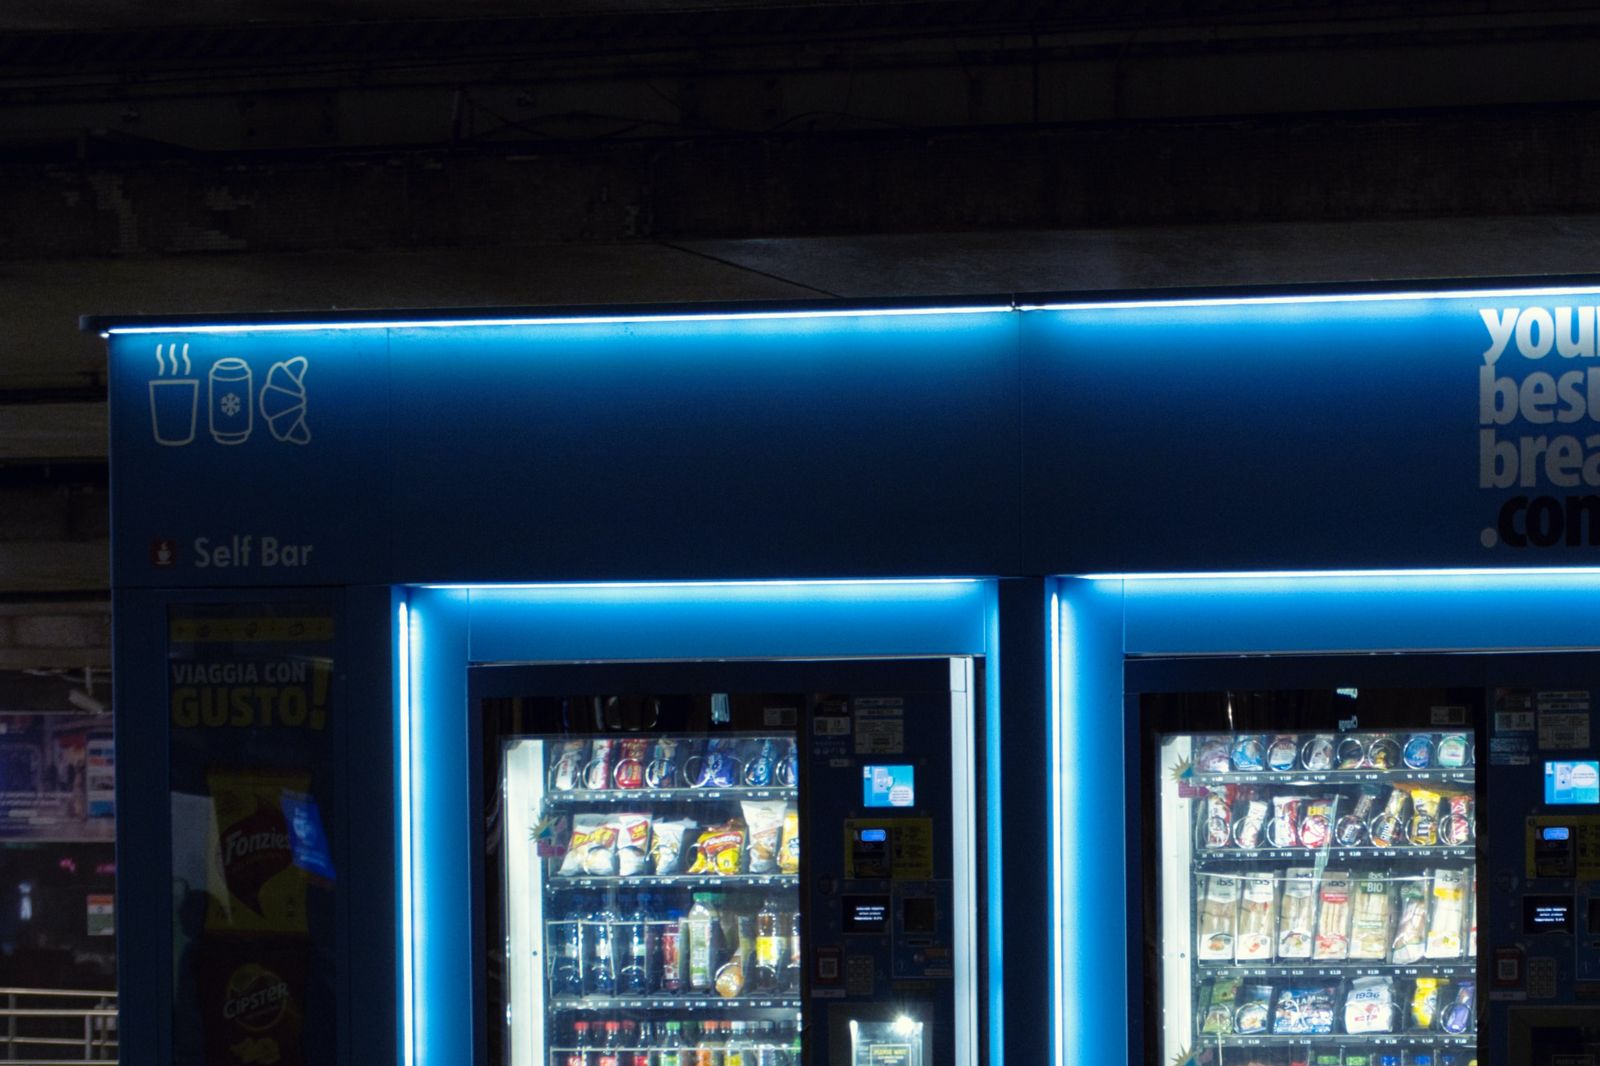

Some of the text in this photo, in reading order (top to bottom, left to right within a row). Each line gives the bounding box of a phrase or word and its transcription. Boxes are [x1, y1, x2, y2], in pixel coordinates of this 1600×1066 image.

[194, 535, 314, 569] Self Bar
[171, 661, 307, 686] VIAGGIA CON
[172, 657, 329, 732] GUSTO!
[223, 826, 291, 867] Fonzies
[1366, 881, 1384, 893] BIO
